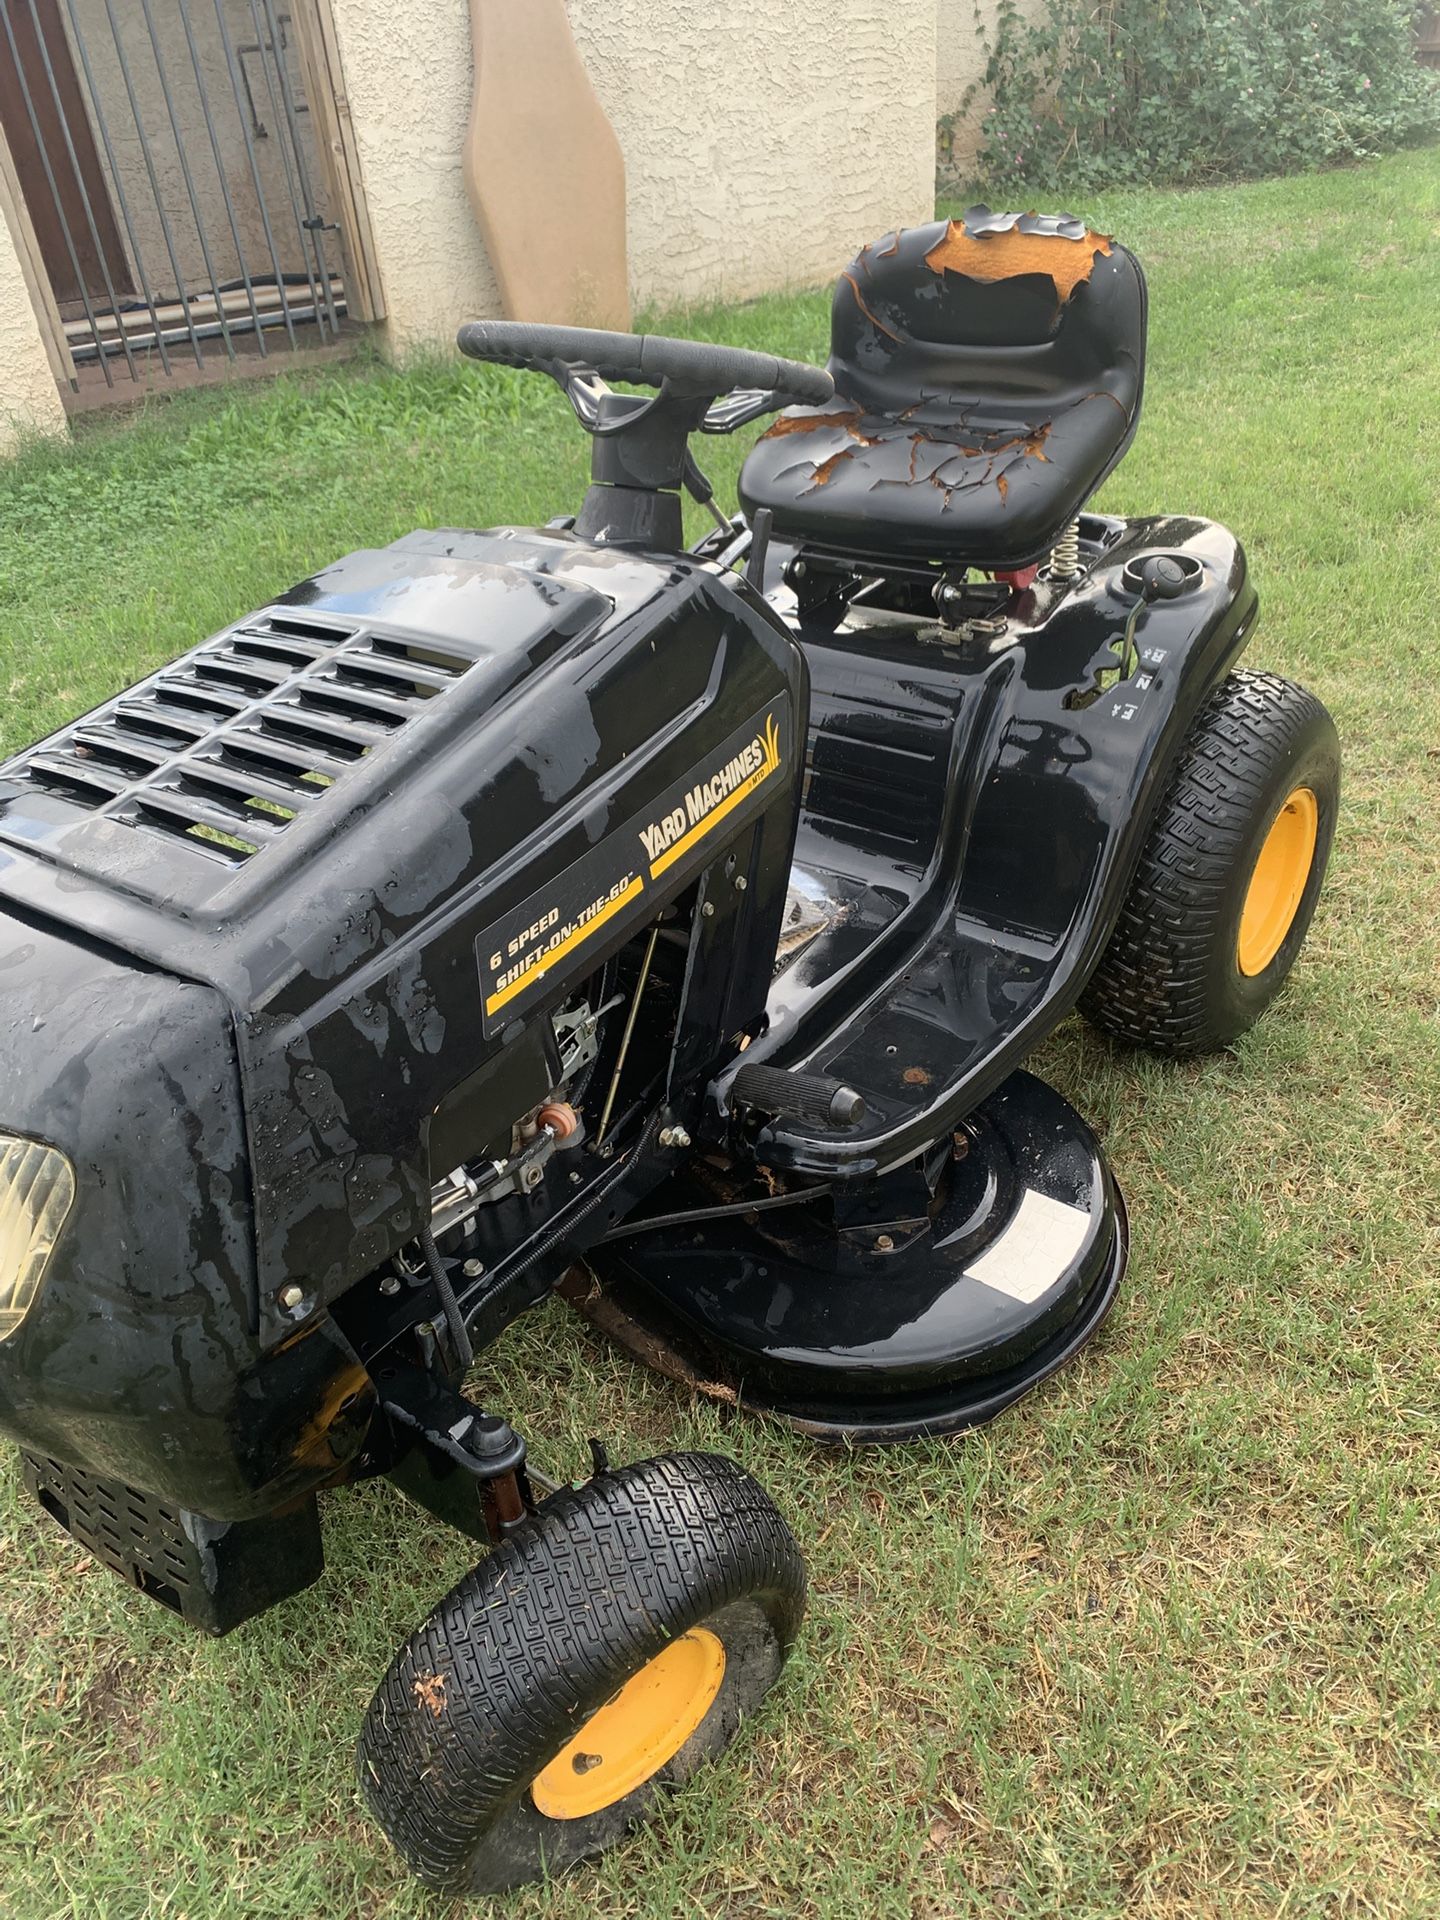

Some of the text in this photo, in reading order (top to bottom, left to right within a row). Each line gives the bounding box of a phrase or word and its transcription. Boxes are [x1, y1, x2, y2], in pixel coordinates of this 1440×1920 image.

[1151, 651, 1165, 663] R
[1135, 677, 1151, 690] N
[1121, 707, 1135, 720] F
[751, 768, 765, 784] MTD
[638, 739, 763, 861] YARD MACHINES
[489, 907, 559, 971] 6 SPEED
